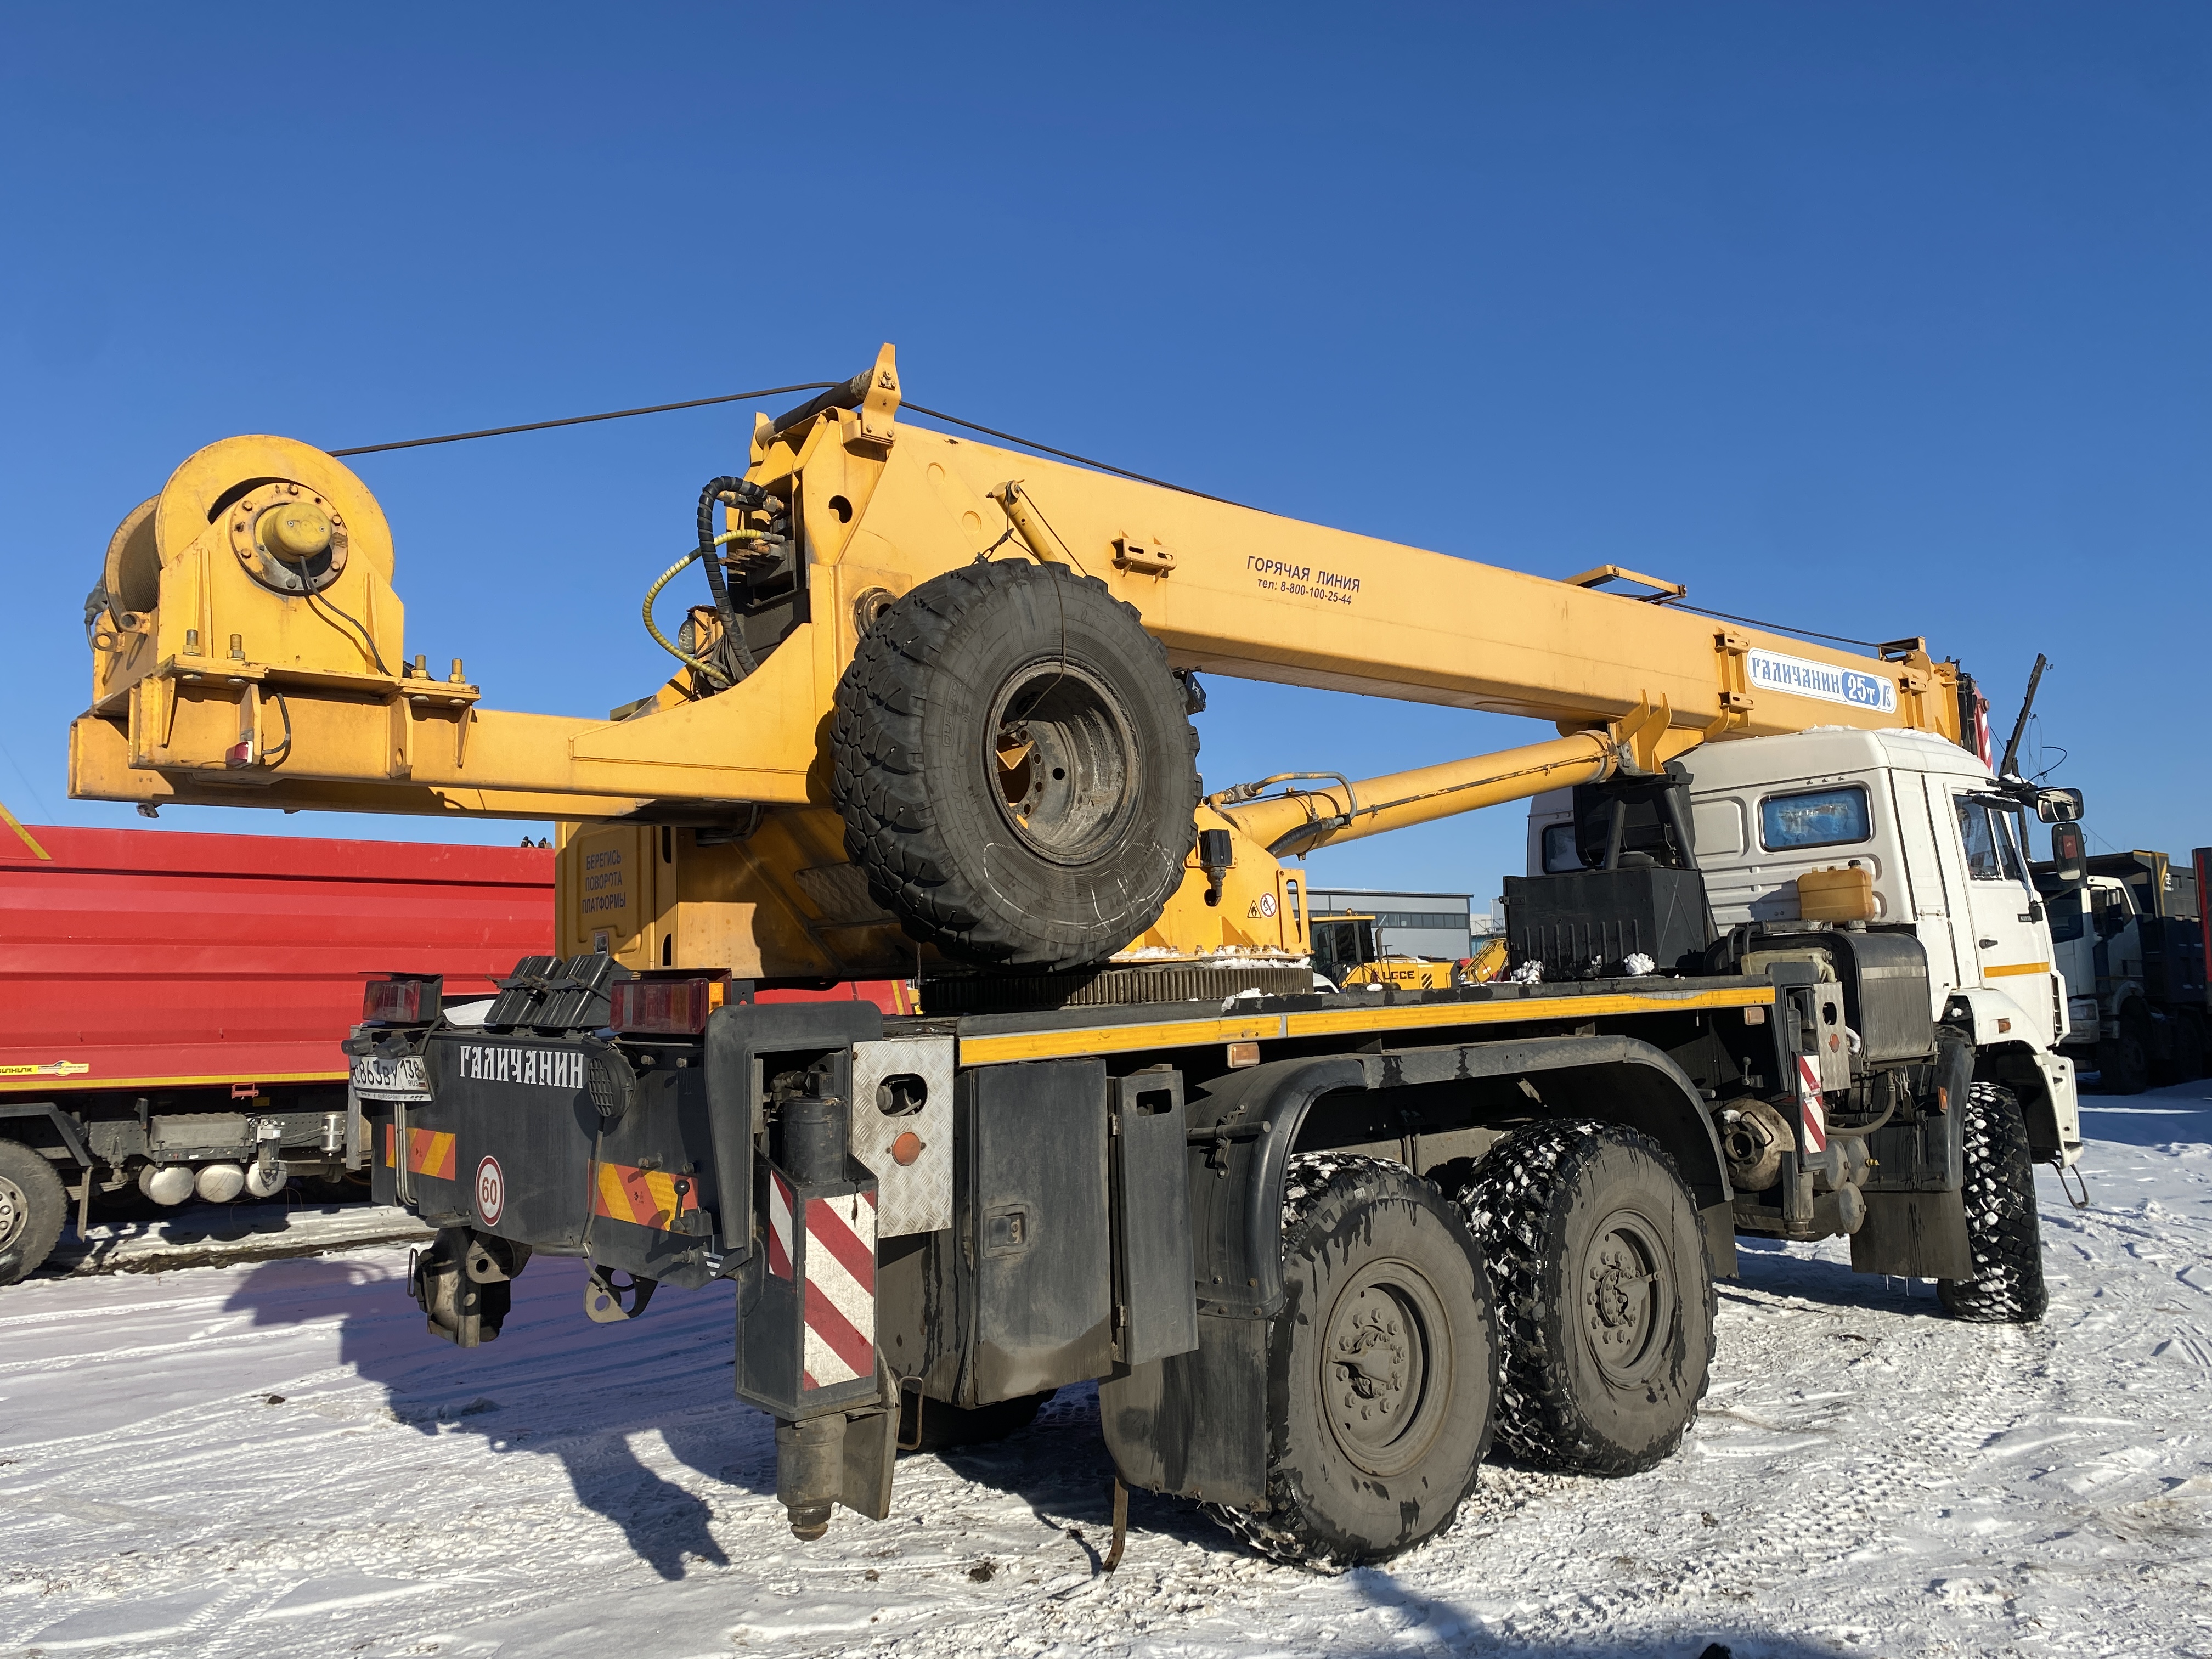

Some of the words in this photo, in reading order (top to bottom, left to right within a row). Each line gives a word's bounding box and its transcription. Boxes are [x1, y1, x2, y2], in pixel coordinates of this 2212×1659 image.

[1247, 556, 1310, 581] ГОРЯЧАЯ
[1317, 571, 1360, 592] ЛИНИЯ
[1257, 579, 1278, 590] тел:
[1280, 582, 1351, 605] 8-800-100-25-44
[1752, 657, 1840, 694] ГАЛИЧАНИН
[586, 850, 622, 870] БЕРЕГИСЬ
[585, 871, 623, 891] ПОВОРОТА
[582, 892, 626, 914] ПЛАТФОРМЫ
[460, 1046, 584, 1089] ГАЛИЧАНИН
[482, 1177, 497, 1205] 60
